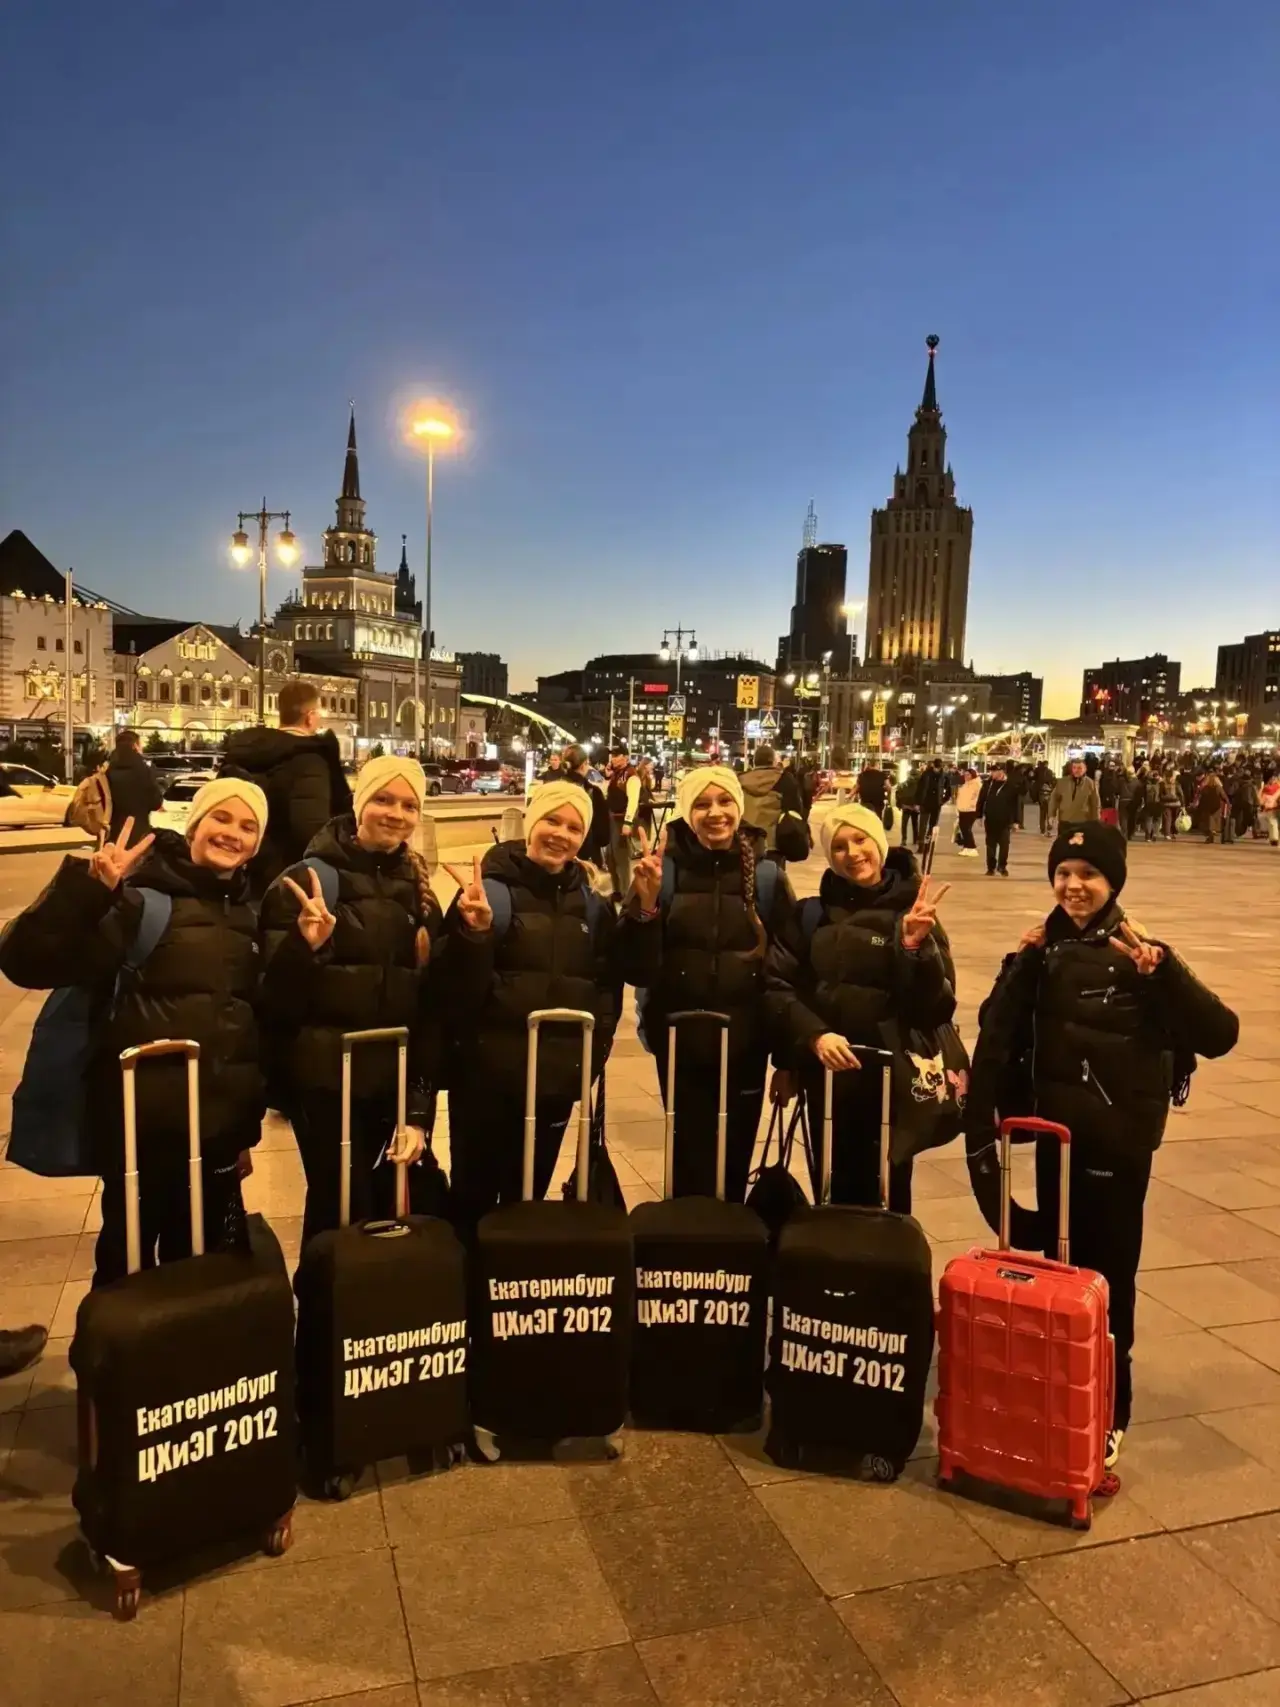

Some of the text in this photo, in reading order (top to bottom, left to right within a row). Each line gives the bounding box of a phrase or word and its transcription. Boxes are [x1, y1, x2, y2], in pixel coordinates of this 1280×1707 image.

[489, 1274, 615, 1300] Екатеринбург
[636, 1268, 751, 1293] Екатеринбург
[492, 1306, 612, 1340] ЦХиЭГ 2012
[638, 1299, 749, 1327] ЦХиЭГ 2012
[783, 1307, 907, 1354] Екатеринбург
[343, 1320, 466, 1361] Екатеринбург
[344, 1348, 465, 1398] ЦХиЭГ 2012
[781, 1340, 905, 1392] ЦХиЭГ 2012
[137, 1370, 277, 1436] Екатеринбург
[139, 1406, 277, 1482] ЦХиЭГ 2012
